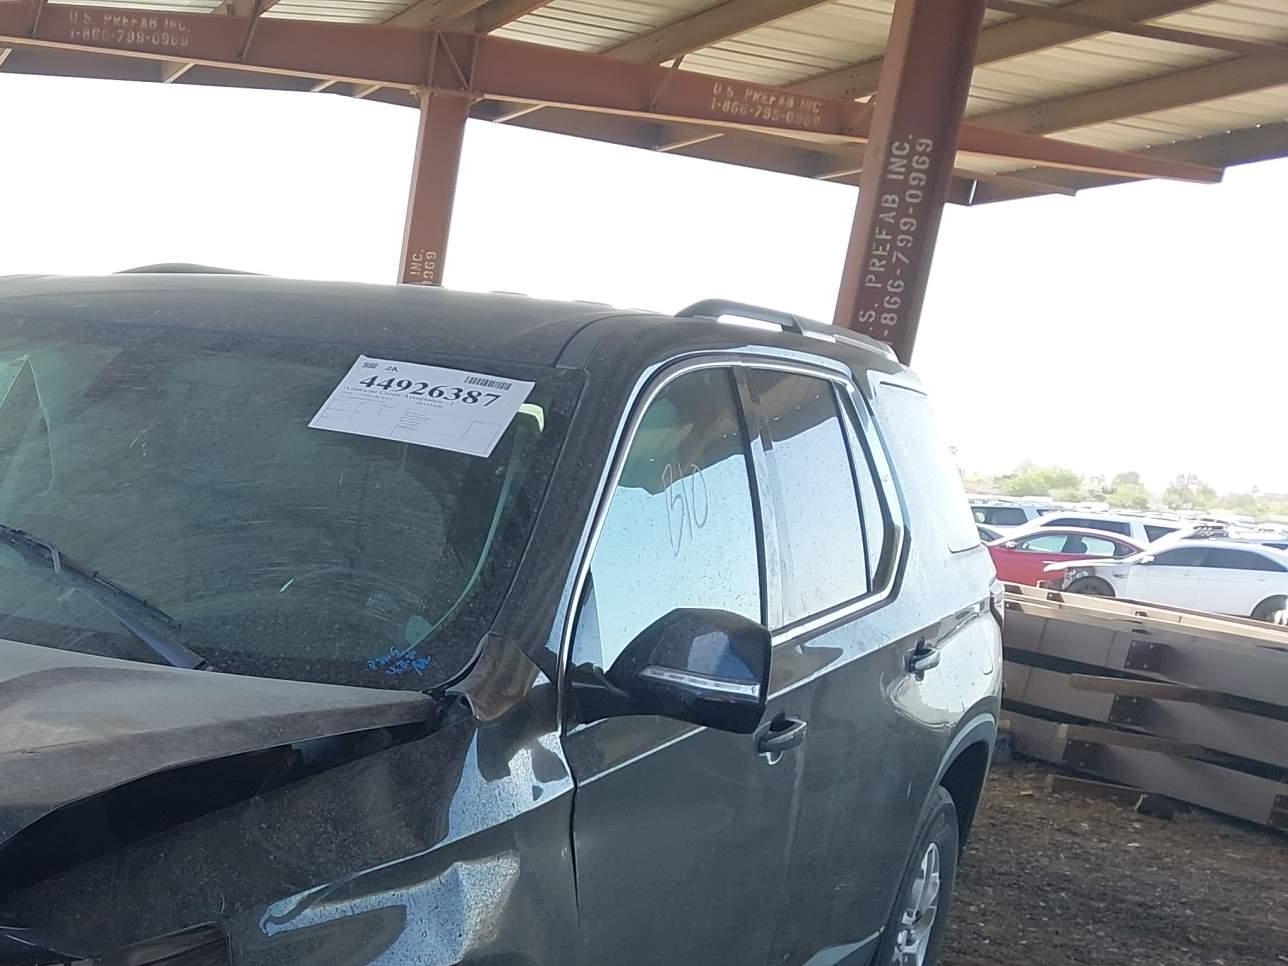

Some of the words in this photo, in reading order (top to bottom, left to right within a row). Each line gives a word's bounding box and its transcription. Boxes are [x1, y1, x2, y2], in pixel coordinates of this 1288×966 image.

[103, 12, 158, 30] PREFAB
[744, 87, 795, 109] PREFAB
[865, 192, 900, 288] PREFAB
[886, 134, 913, 180] INC.
[880, 138, 933, 338] -866-799-0969
[410, 248, 424, 276] INC.
[359, 375, 502, 407] 44926387
